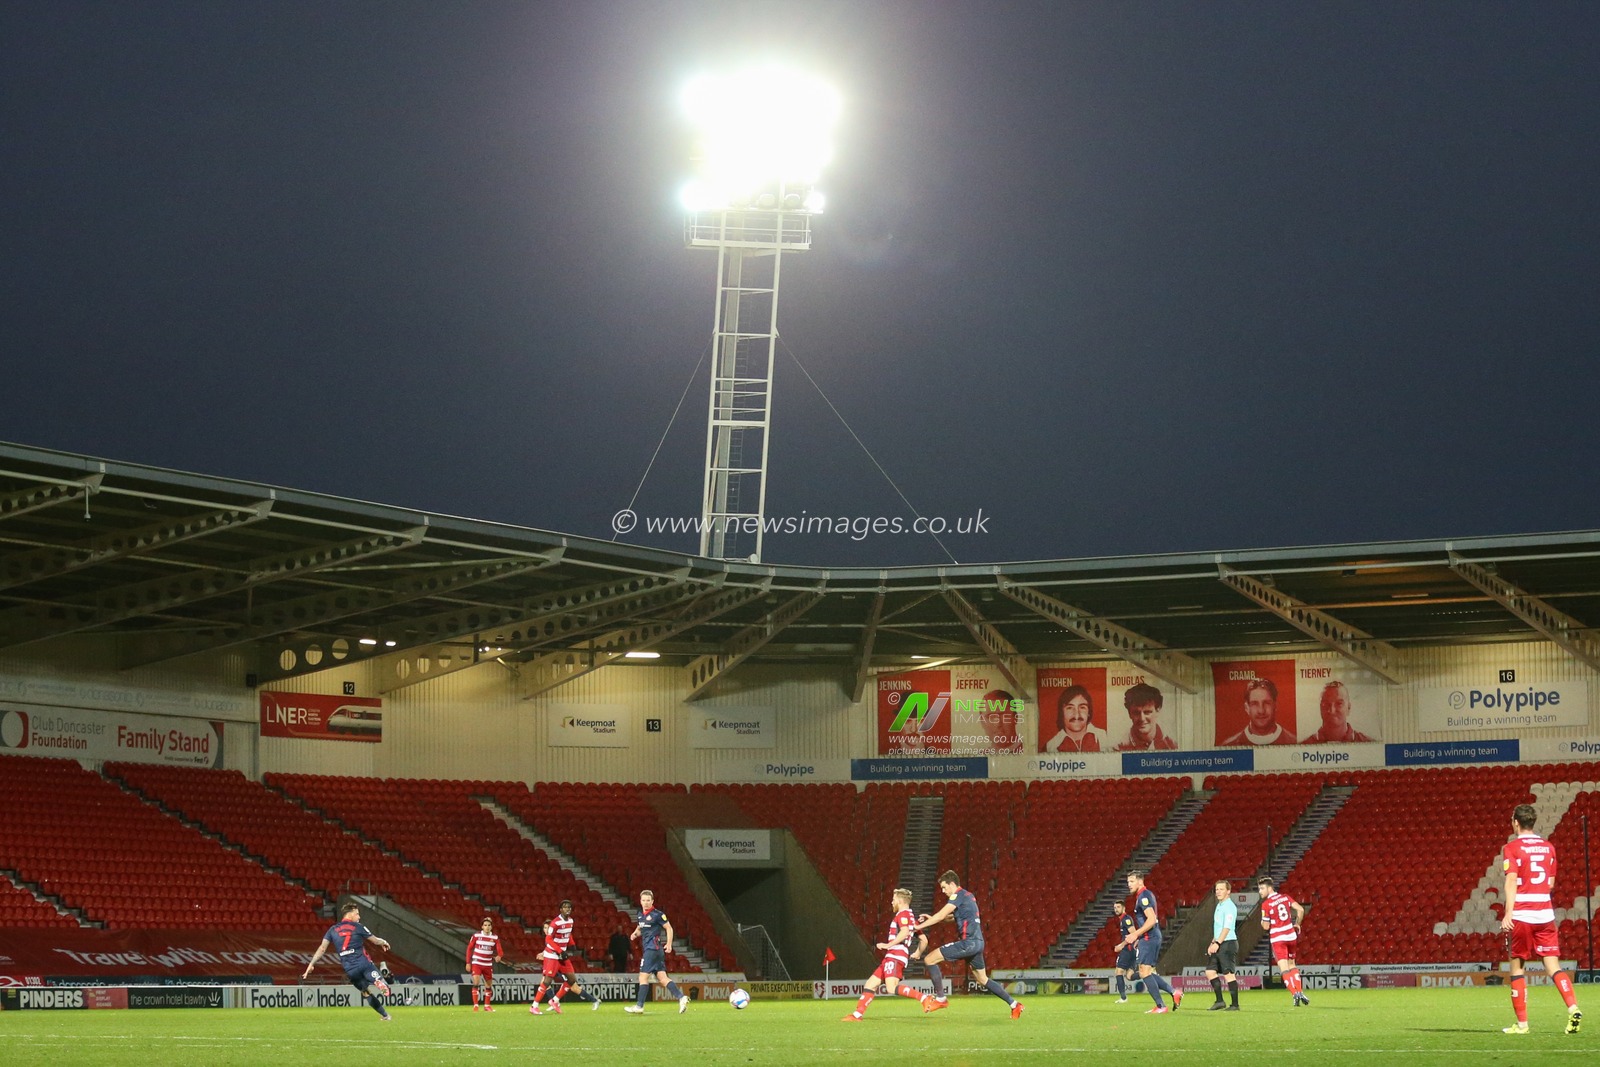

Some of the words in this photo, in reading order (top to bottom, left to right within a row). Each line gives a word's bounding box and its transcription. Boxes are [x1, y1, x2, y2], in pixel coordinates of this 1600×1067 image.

[1229, 670, 1256, 681] CRAMB
[1300, 668, 1331, 679] TIERNEY
[1501, 672, 1513, 682] 16
[344, 683, 354, 693] 12
[879, 680, 912, 691] JENKINS
[955, 679, 989, 690] JEFFREY
[1041, 677, 1073, 688] KITCHEN
[1111, 676, 1145, 687] DOUGLAS
[1470, 687, 1560, 712] Polypipe
[266, 704, 308, 727] LNER
[1447, 716, 1483, 727] Building
[1494, 716, 1531, 726] winning
[1534, 714, 1557, 723] team
[32, 715, 54, 731] Club
[57, 717, 106, 735] Doncaster
[576, 719, 615, 728] Keepmoat
[648, 720, 660, 730] 13
[719, 720, 760, 730] Keepmoat
[32, 732, 87, 750] Foundation
[117, 725, 165, 755] Family
[169, 730, 209, 753] Stand
[1303, 751, 1349, 765] Polypipe
[1404, 749, 1436, 760] Building
[1444, 748, 1476, 758] winning
[1478, 747, 1498, 755] team
[870, 764, 902, 774] Building
[912, 764, 944, 774] winning
[946, 764, 967, 772] team
[1039, 759, 1086, 773] Polypipe
[1141, 758, 1173, 768] Building
[1181, 757, 1212, 767] winning
[1214, 757, 1234, 765] team
[766, 764, 814, 777] Polypipe
[715, 840, 755, 849] Keepmoat
[1530, 855, 1546, 885] 5
[1277, 903, 1288, 921] 8
[338, 931, 352, 950] 7
[150, 946, 222, 968] with
[751, 983, 769, 992] PRIVATE
[771, 983, 799, 992] EXECUTIVE
[801, 983, 812, 992] HIRE
[1302, 976, 1361, 989] NDERS
[1421, 975, 1474, 988] PUKKA
[703, 985, 731, 1000] PUKKA
[832, 985, 850, 995] RED
[20, 990, 84, 1008] PINDERS
[131, 994, 142, 1005] the
[143, 995, 165, 1005] crown
[166, 994, 184, 1005] hotel
[251, 988, 303, 1008] Football
[317, 988, 350, 1007] Index
[423, 987, 454, 1007] Index
